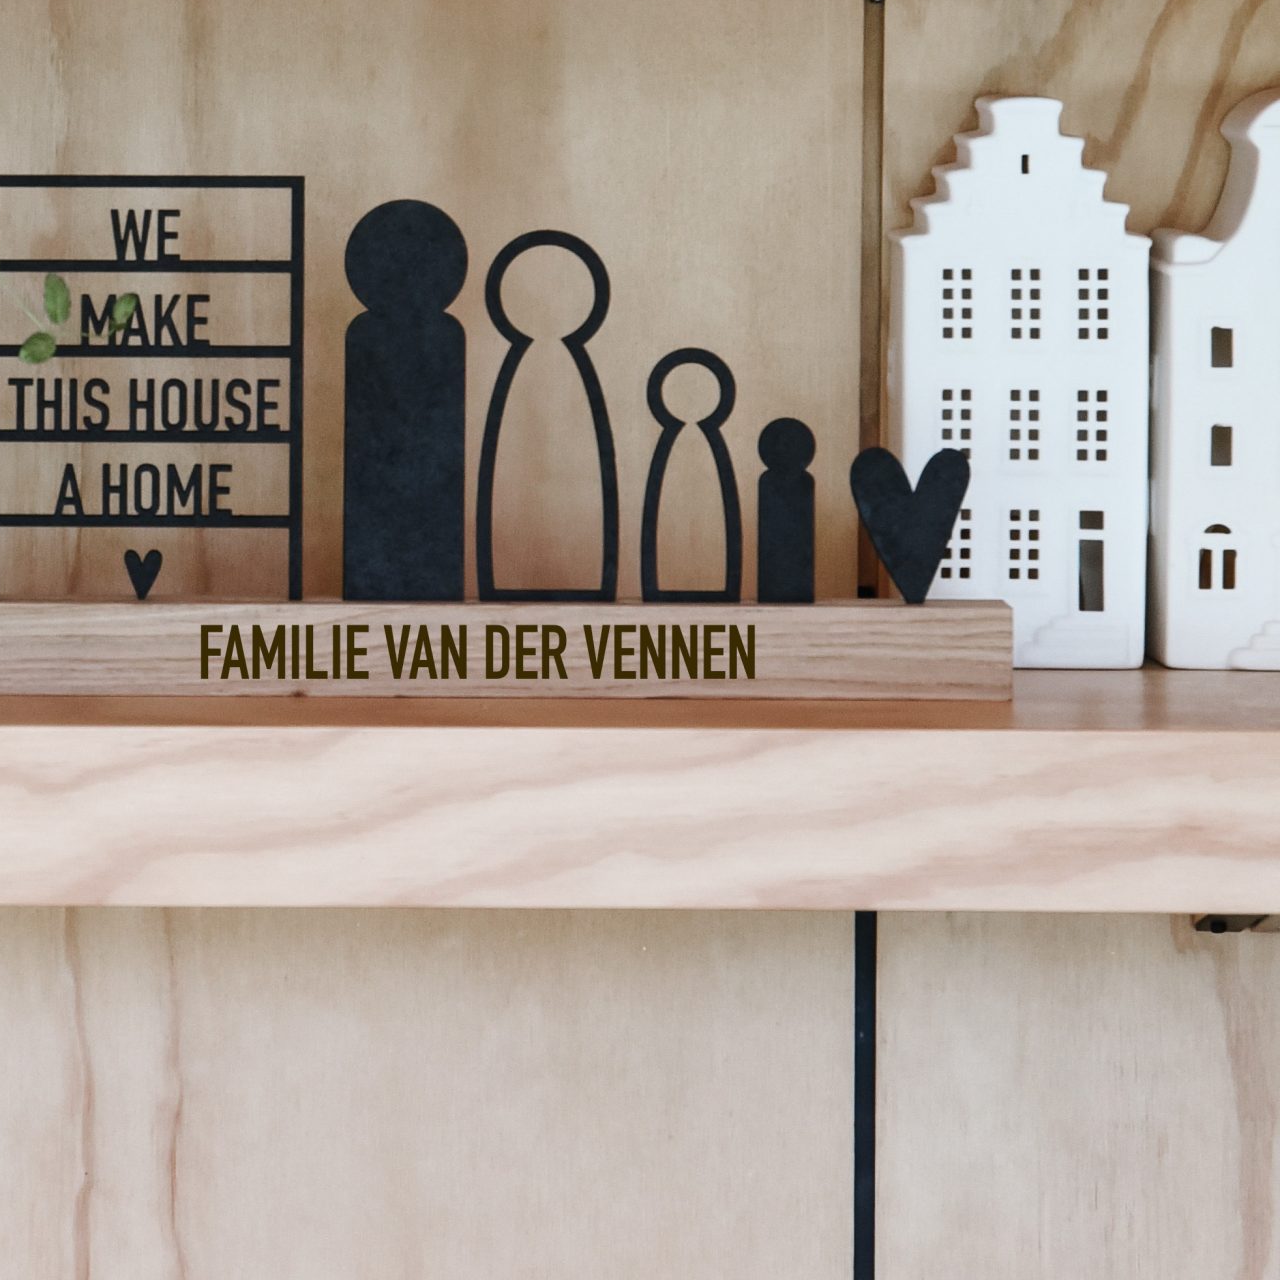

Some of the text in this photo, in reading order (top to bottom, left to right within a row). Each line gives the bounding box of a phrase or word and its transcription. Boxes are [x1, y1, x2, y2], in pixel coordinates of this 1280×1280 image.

[110, 209, 181, 261] WE
[80, 293, 210, 347] MAKE
[8, 378, 280, 432] THIS HOUSE
[53, 463, 232, 516] A HOME
[200, 624, 756, 679] FAMILIE VAN DER VENNEN
